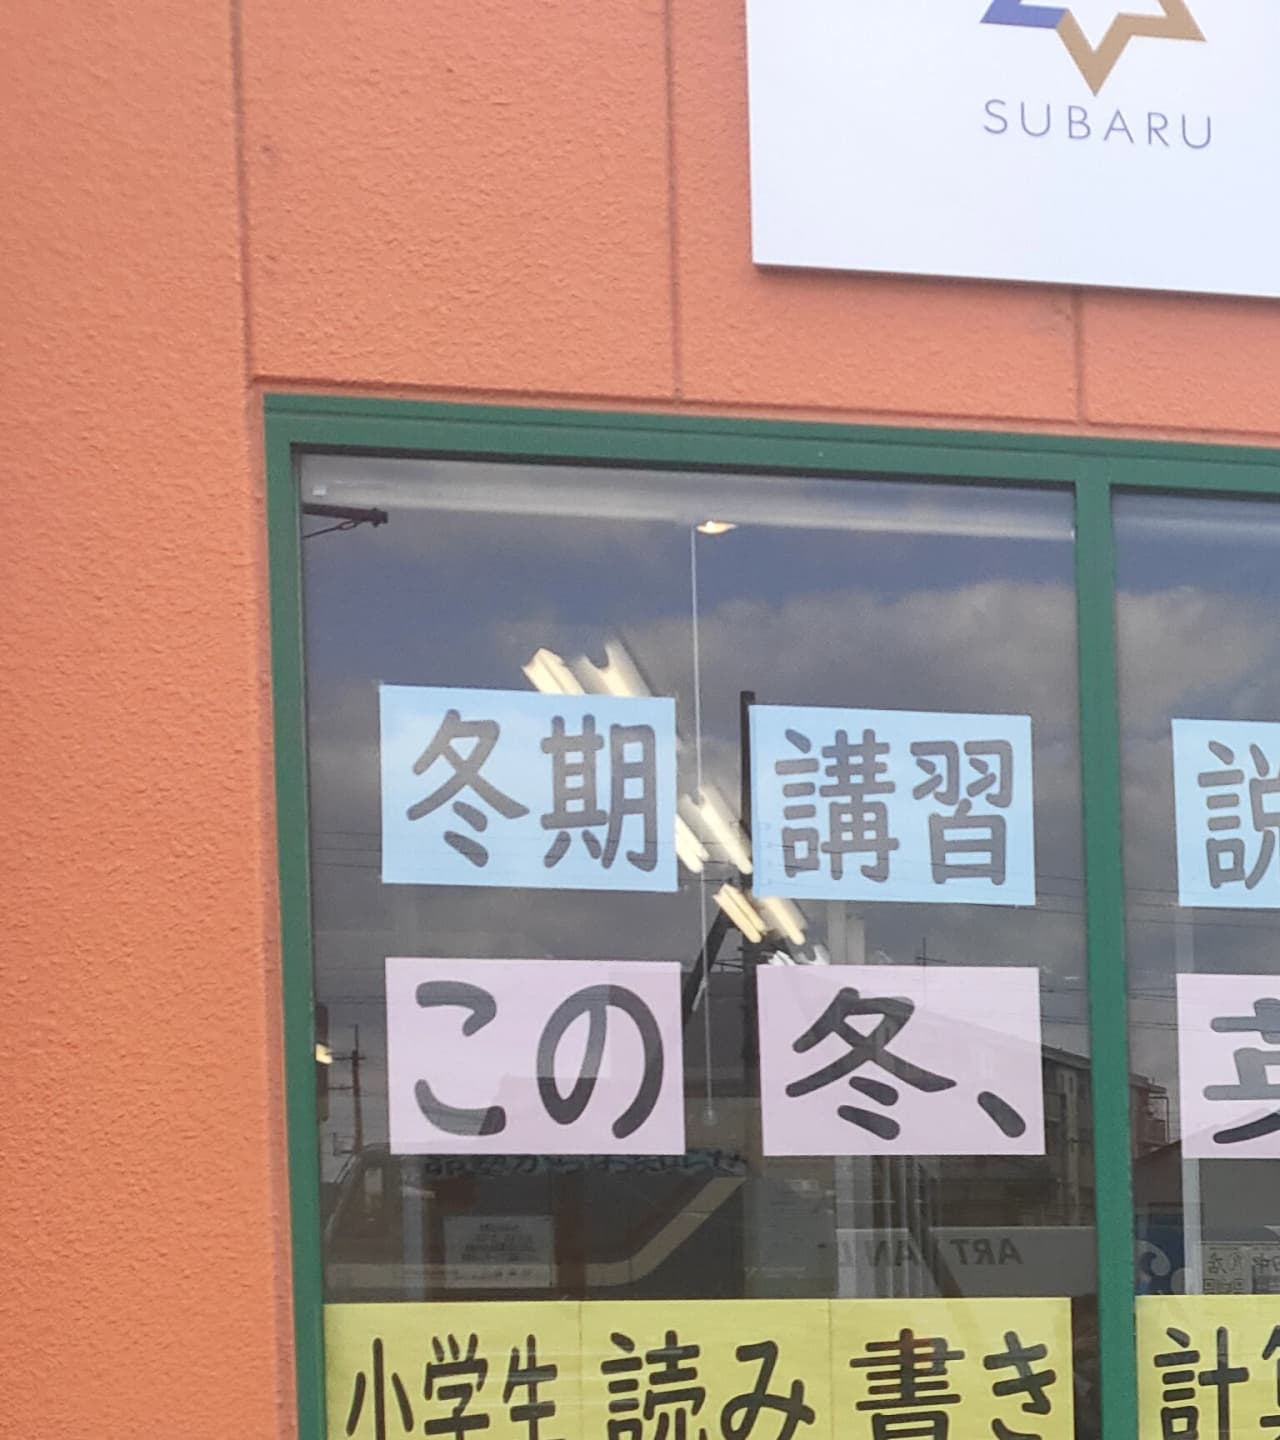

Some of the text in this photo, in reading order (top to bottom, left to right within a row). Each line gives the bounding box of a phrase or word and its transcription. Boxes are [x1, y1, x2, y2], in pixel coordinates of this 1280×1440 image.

[981, 98, 1215, 152] SUBARU
[405, 708, 661, 872] 冬期
[774, 728, 1015, 886] 講習
